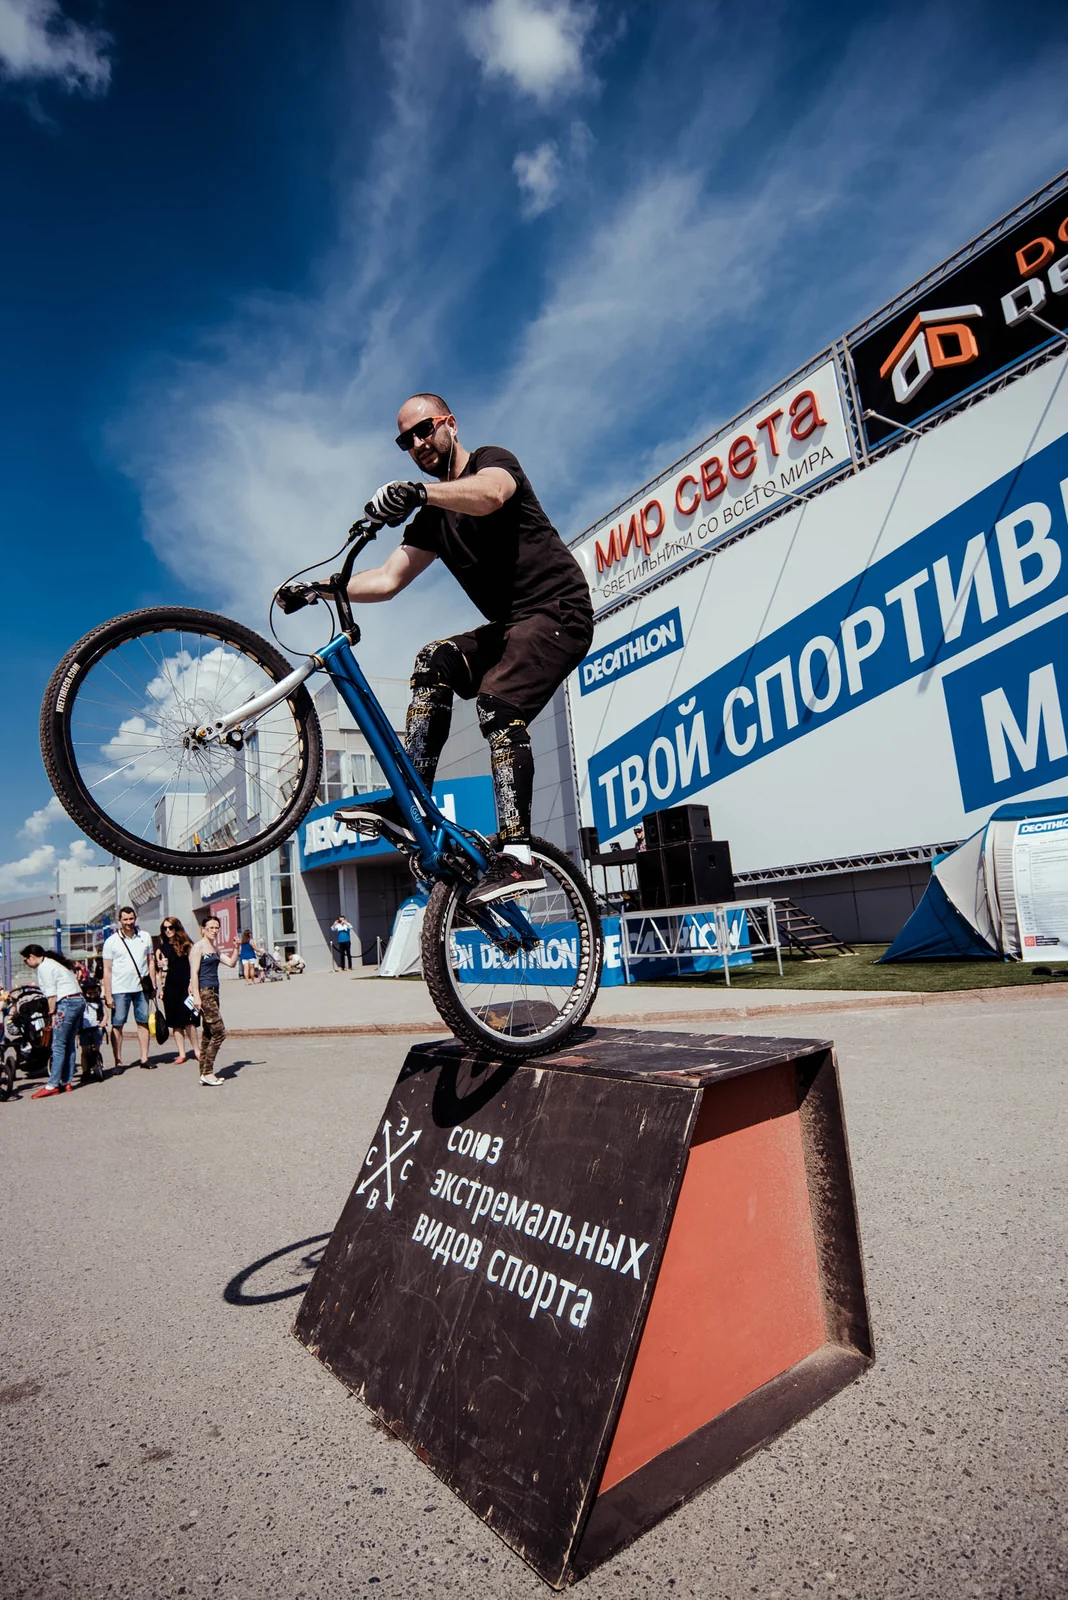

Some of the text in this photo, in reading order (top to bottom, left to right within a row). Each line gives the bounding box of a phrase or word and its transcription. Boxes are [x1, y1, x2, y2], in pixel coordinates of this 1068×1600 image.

[603, 446, 834, 598] СВЕТИЛЬНИКИ СО ВСЕГО МИРА
[583, 619, 677, 687] DECATHLON
[598, 477, 1068, 829] ТВОЙ СПОРТИВ
[55, 662, 82, 713] VEETIRECO.COM
[602, 919, 740, 969] ECATHLON
